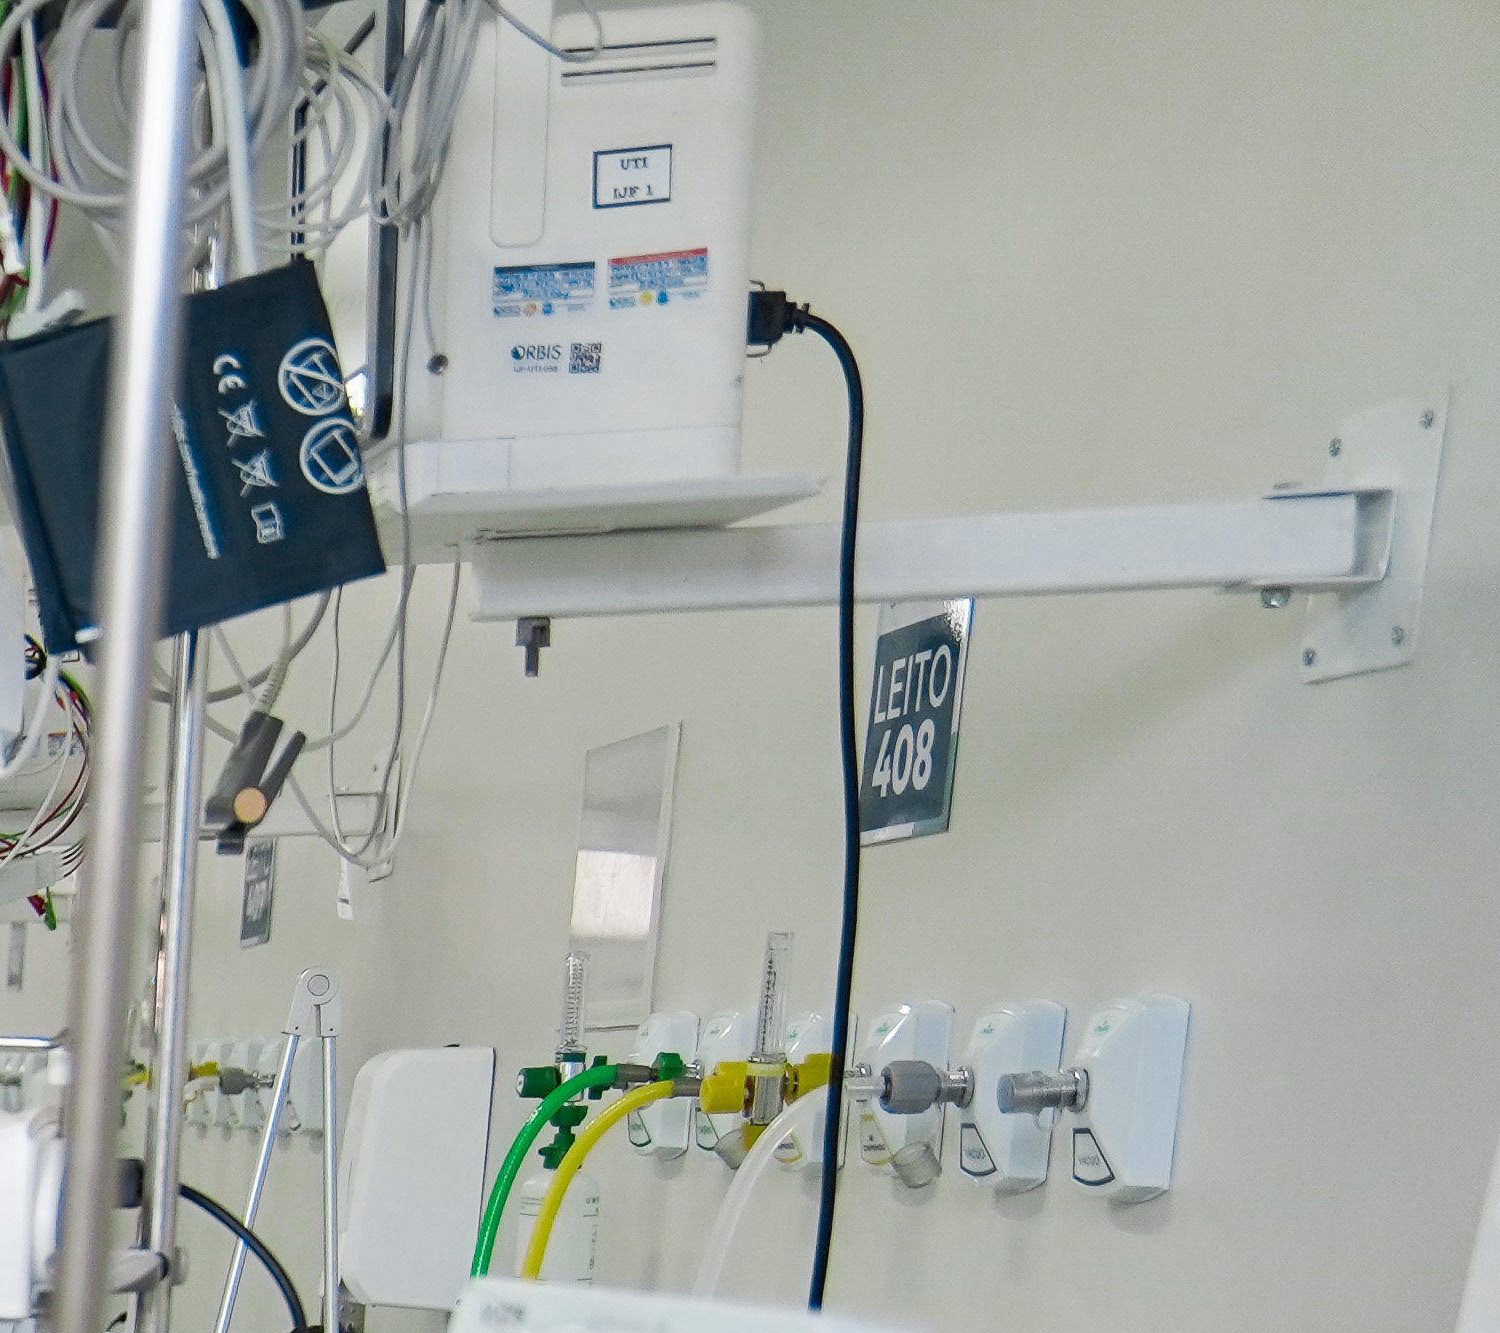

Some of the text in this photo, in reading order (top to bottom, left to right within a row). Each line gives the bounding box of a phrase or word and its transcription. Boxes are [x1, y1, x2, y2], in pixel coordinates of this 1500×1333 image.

[620, 156, 649, 171] UTI
[646, 184, 654, 197] 1
[510, 344, 563, 361] ORBIS
[873, 644, 952, 725] LEITO
[871, 718, 936, 798] 408
